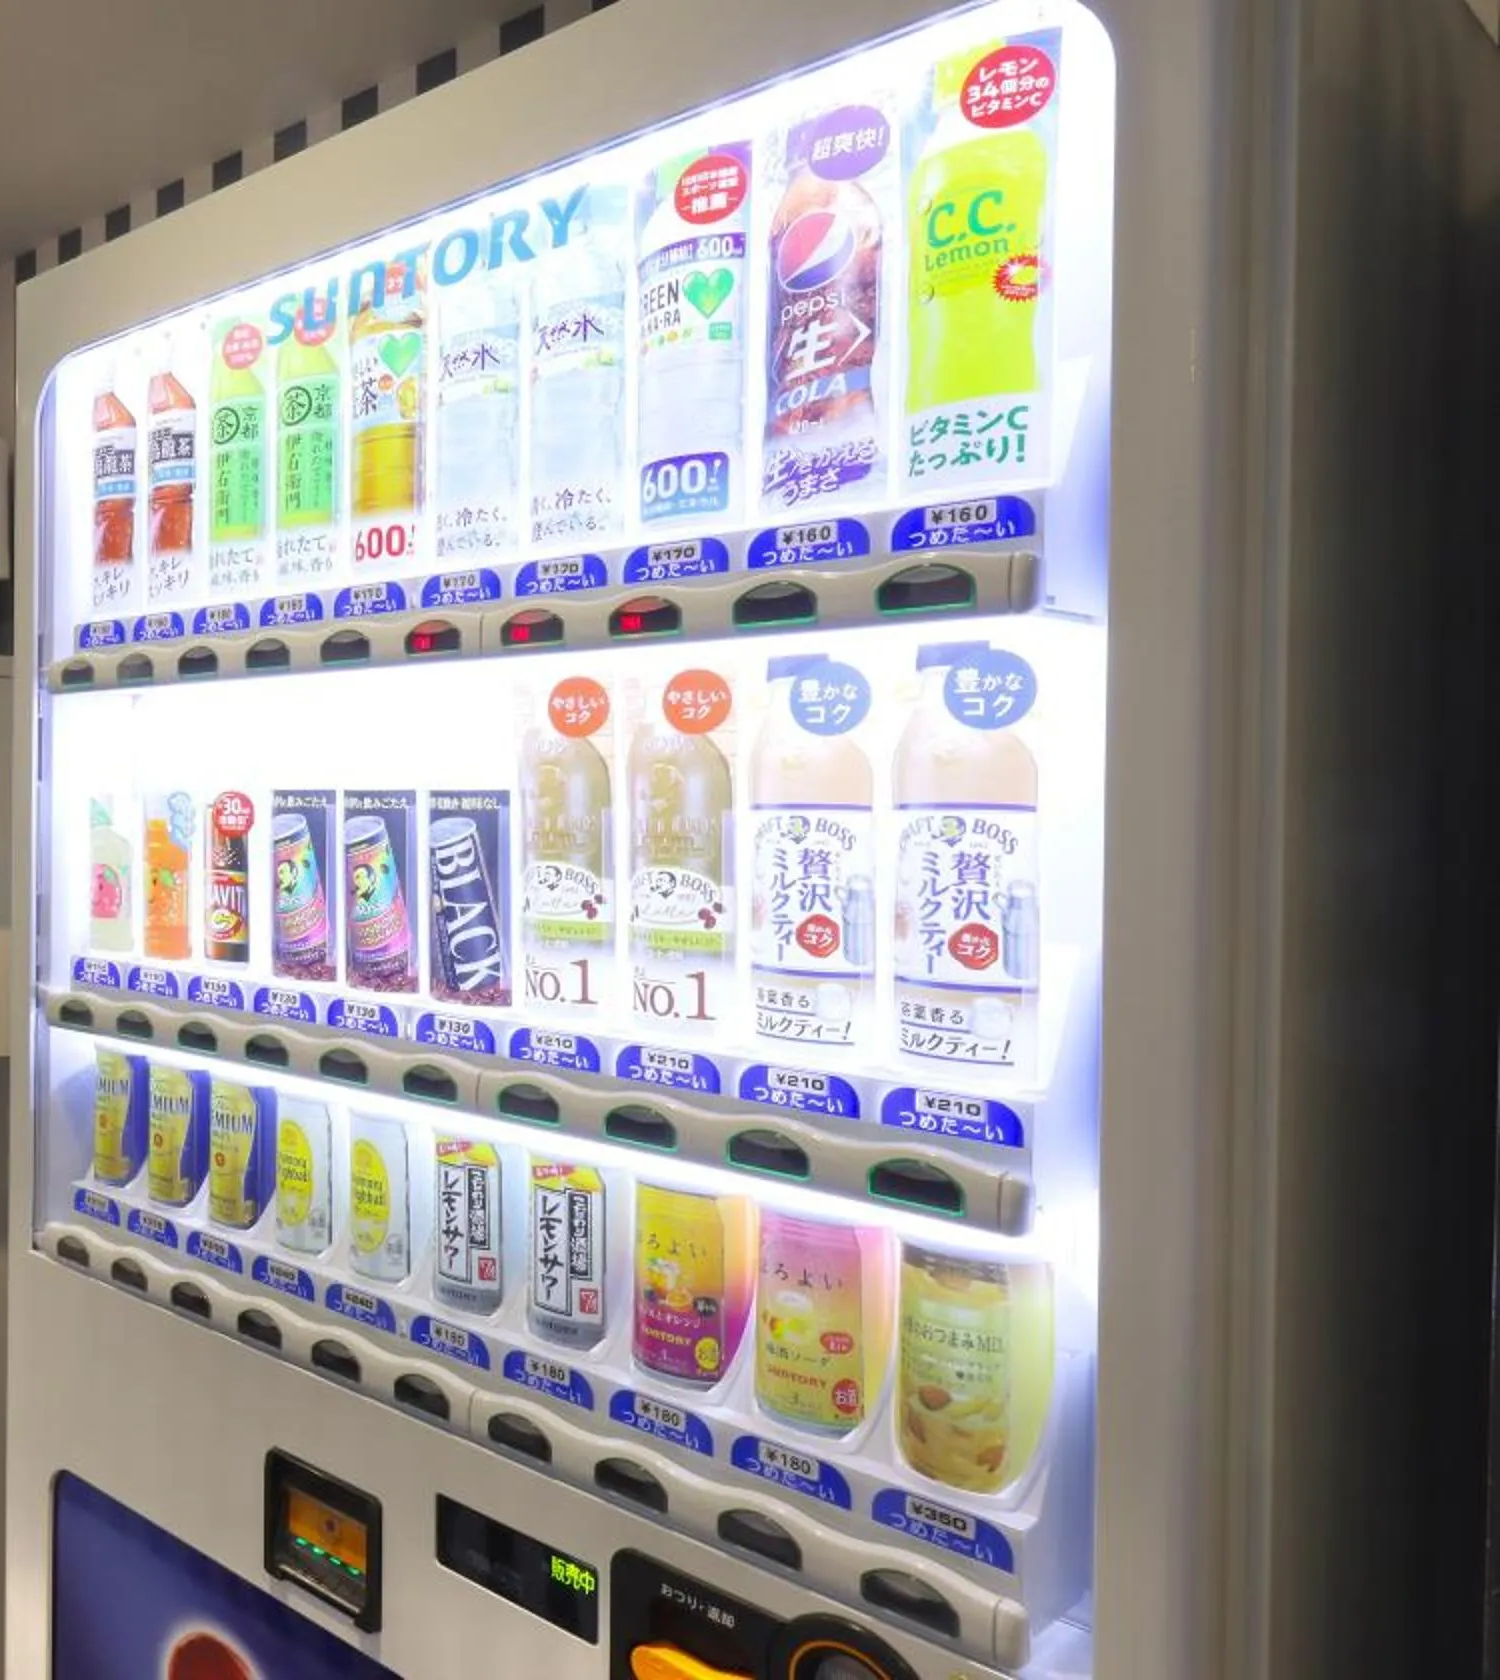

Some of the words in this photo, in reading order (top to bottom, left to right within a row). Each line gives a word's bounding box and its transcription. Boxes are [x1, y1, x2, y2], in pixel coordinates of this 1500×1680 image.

[979, 57, 1040, 83] レモン
[967, 75, 1050, 105] 34個分の
[970, 92, 1044, 119] ビタミンC
[812, 127, 885, 162] 超爽快!
[926, 189, 1017, 250] C.C.
[924, 236, 1010, 273] Lemon
[780, 289, 846, 326] pepsi
[784, 317, 842, 382] 生
[774, 371, 848, 418] COLA
[908, 404, 1029, 448] ビタミンC
[907, 433, 1027, 478] たっぷり!
[931, 503, 988, 525] ¥160
[798, 679, 859, 703] 豊かな
[953, 668, 1024, 695] 豊かな
[551, 691, 605, 712] やさしい
[668, 688, 726, 708] やさしい
[681, 704, 711, 721] コク
[806, 702, 851, 725] コク
[963, 694, 1015, 719] コク
[565, 709, 591, 725] コク
[815, 816, 857, 851] BOSS
[971, 818, 1019, 857] BOSS
[564, 867, 598, 895] BOSS
[679, 873, 717, 903] BOSS
[797, 847, 833, 913] 贅沢
[950, 850, 992, 921] 贅沢
[435, 838, 501, 992] BLACK
[770, 848, 797, 962] ミルクティー
[917, 851, 949, 975] ミルクティー
[775, 1072, 826, 1092] ¥210
[924, 1094, 982, 1118] ¥210
[441, 1169, 465, 1270] レモンサワー
[539, 1194, 565, 1301] レモンサワー
[646, 1233, 708, 1259] ろよい
[639, 1401, 680, 1427] ¥180
[763, 1447, 813, 1476] ¥180
[910, 1502, 969, 1534] ¥350
[550, 1555, 596, 1595] 販売中
